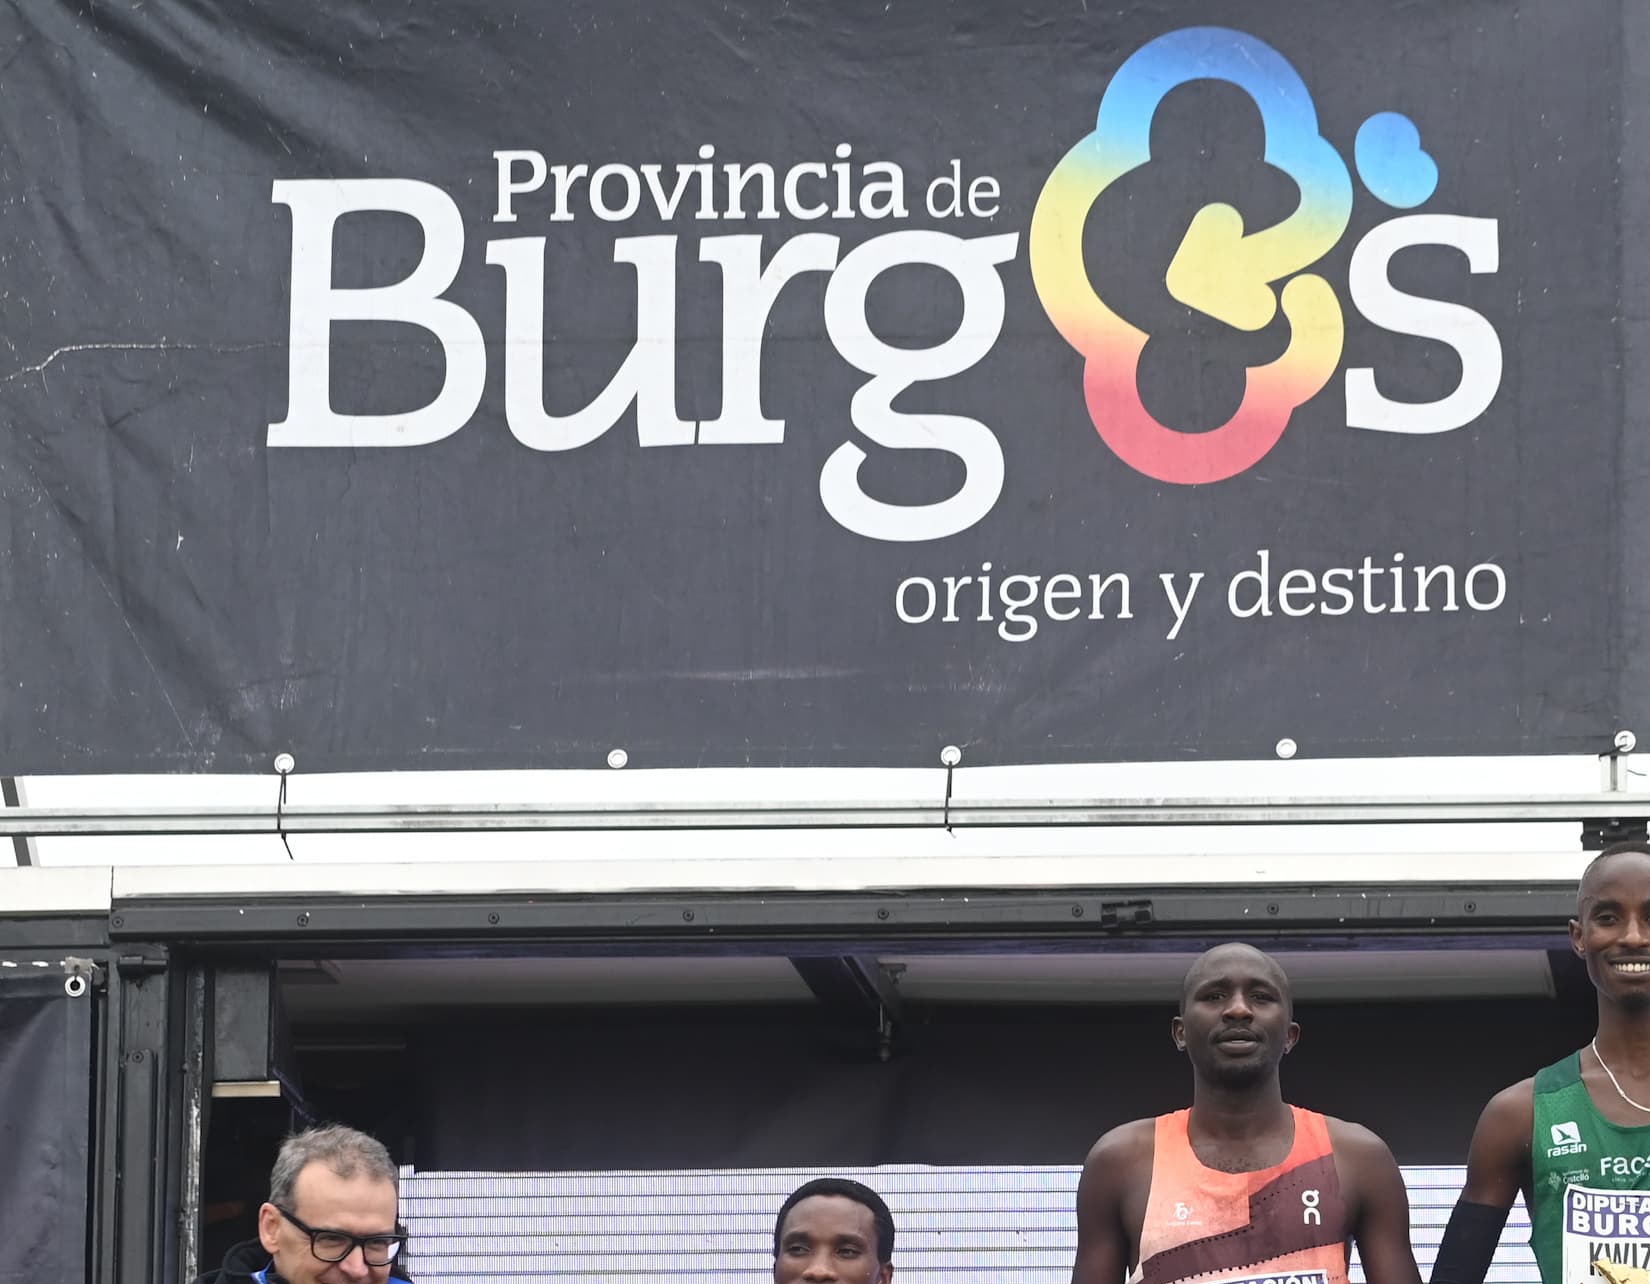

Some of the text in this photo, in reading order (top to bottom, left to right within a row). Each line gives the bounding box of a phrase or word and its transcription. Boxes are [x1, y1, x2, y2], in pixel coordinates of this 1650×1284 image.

[492, 143, 1003, 223] Provincia de
[265, 25, 1504, 542] Burgos
[894, 549, 1508, 642] origen y destino
